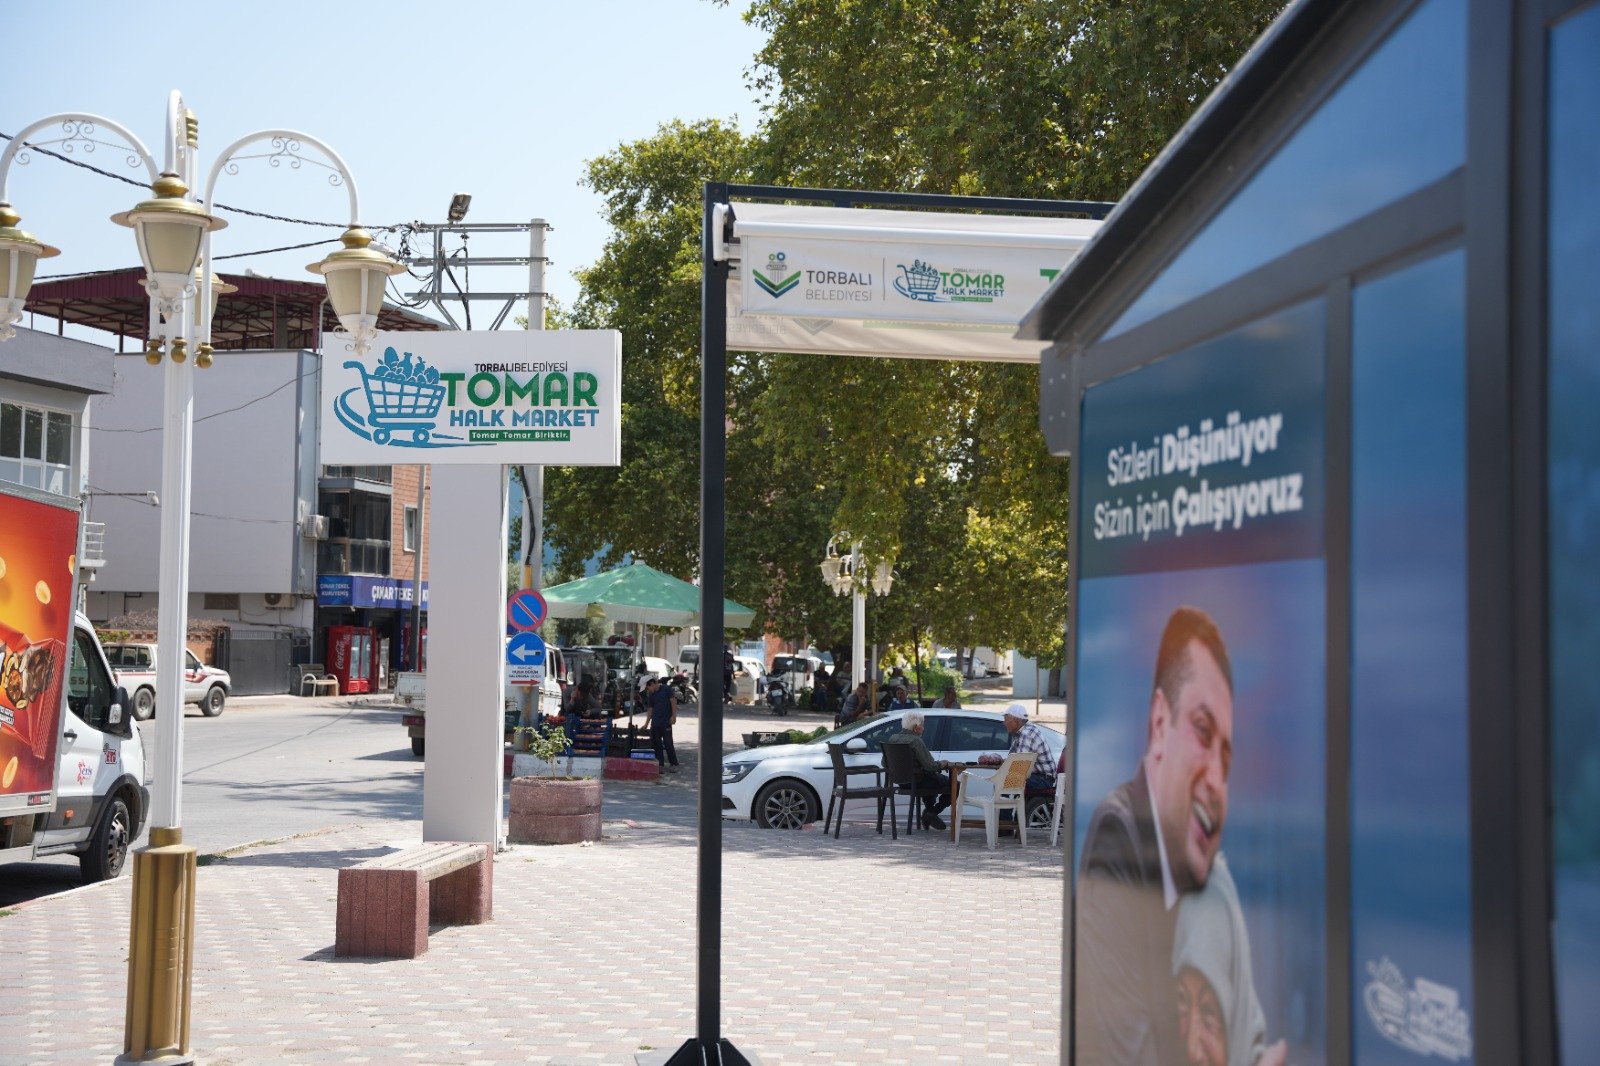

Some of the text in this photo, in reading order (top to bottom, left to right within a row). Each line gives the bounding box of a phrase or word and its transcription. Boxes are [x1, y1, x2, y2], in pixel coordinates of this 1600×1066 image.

[805, 270, 872, 285] TORBALI
[939, 272, 1005, 289] TOMAR
[942, 288, 1005, 298] HALK MARKET
[440, 372, 599, 407] TOMAR
[450, 409, 600, 427] HALK MARKET
[471, 431, 500, 439] Tomar
[503, 431, 531, 439] Tomar
[1107, 410, 1283, 487] Sizleri Düşünüyor
[1094, 473, 1303, 541] Sizin için Çalışıyoruz
[371, 585, 394, 603] ÇINAR
